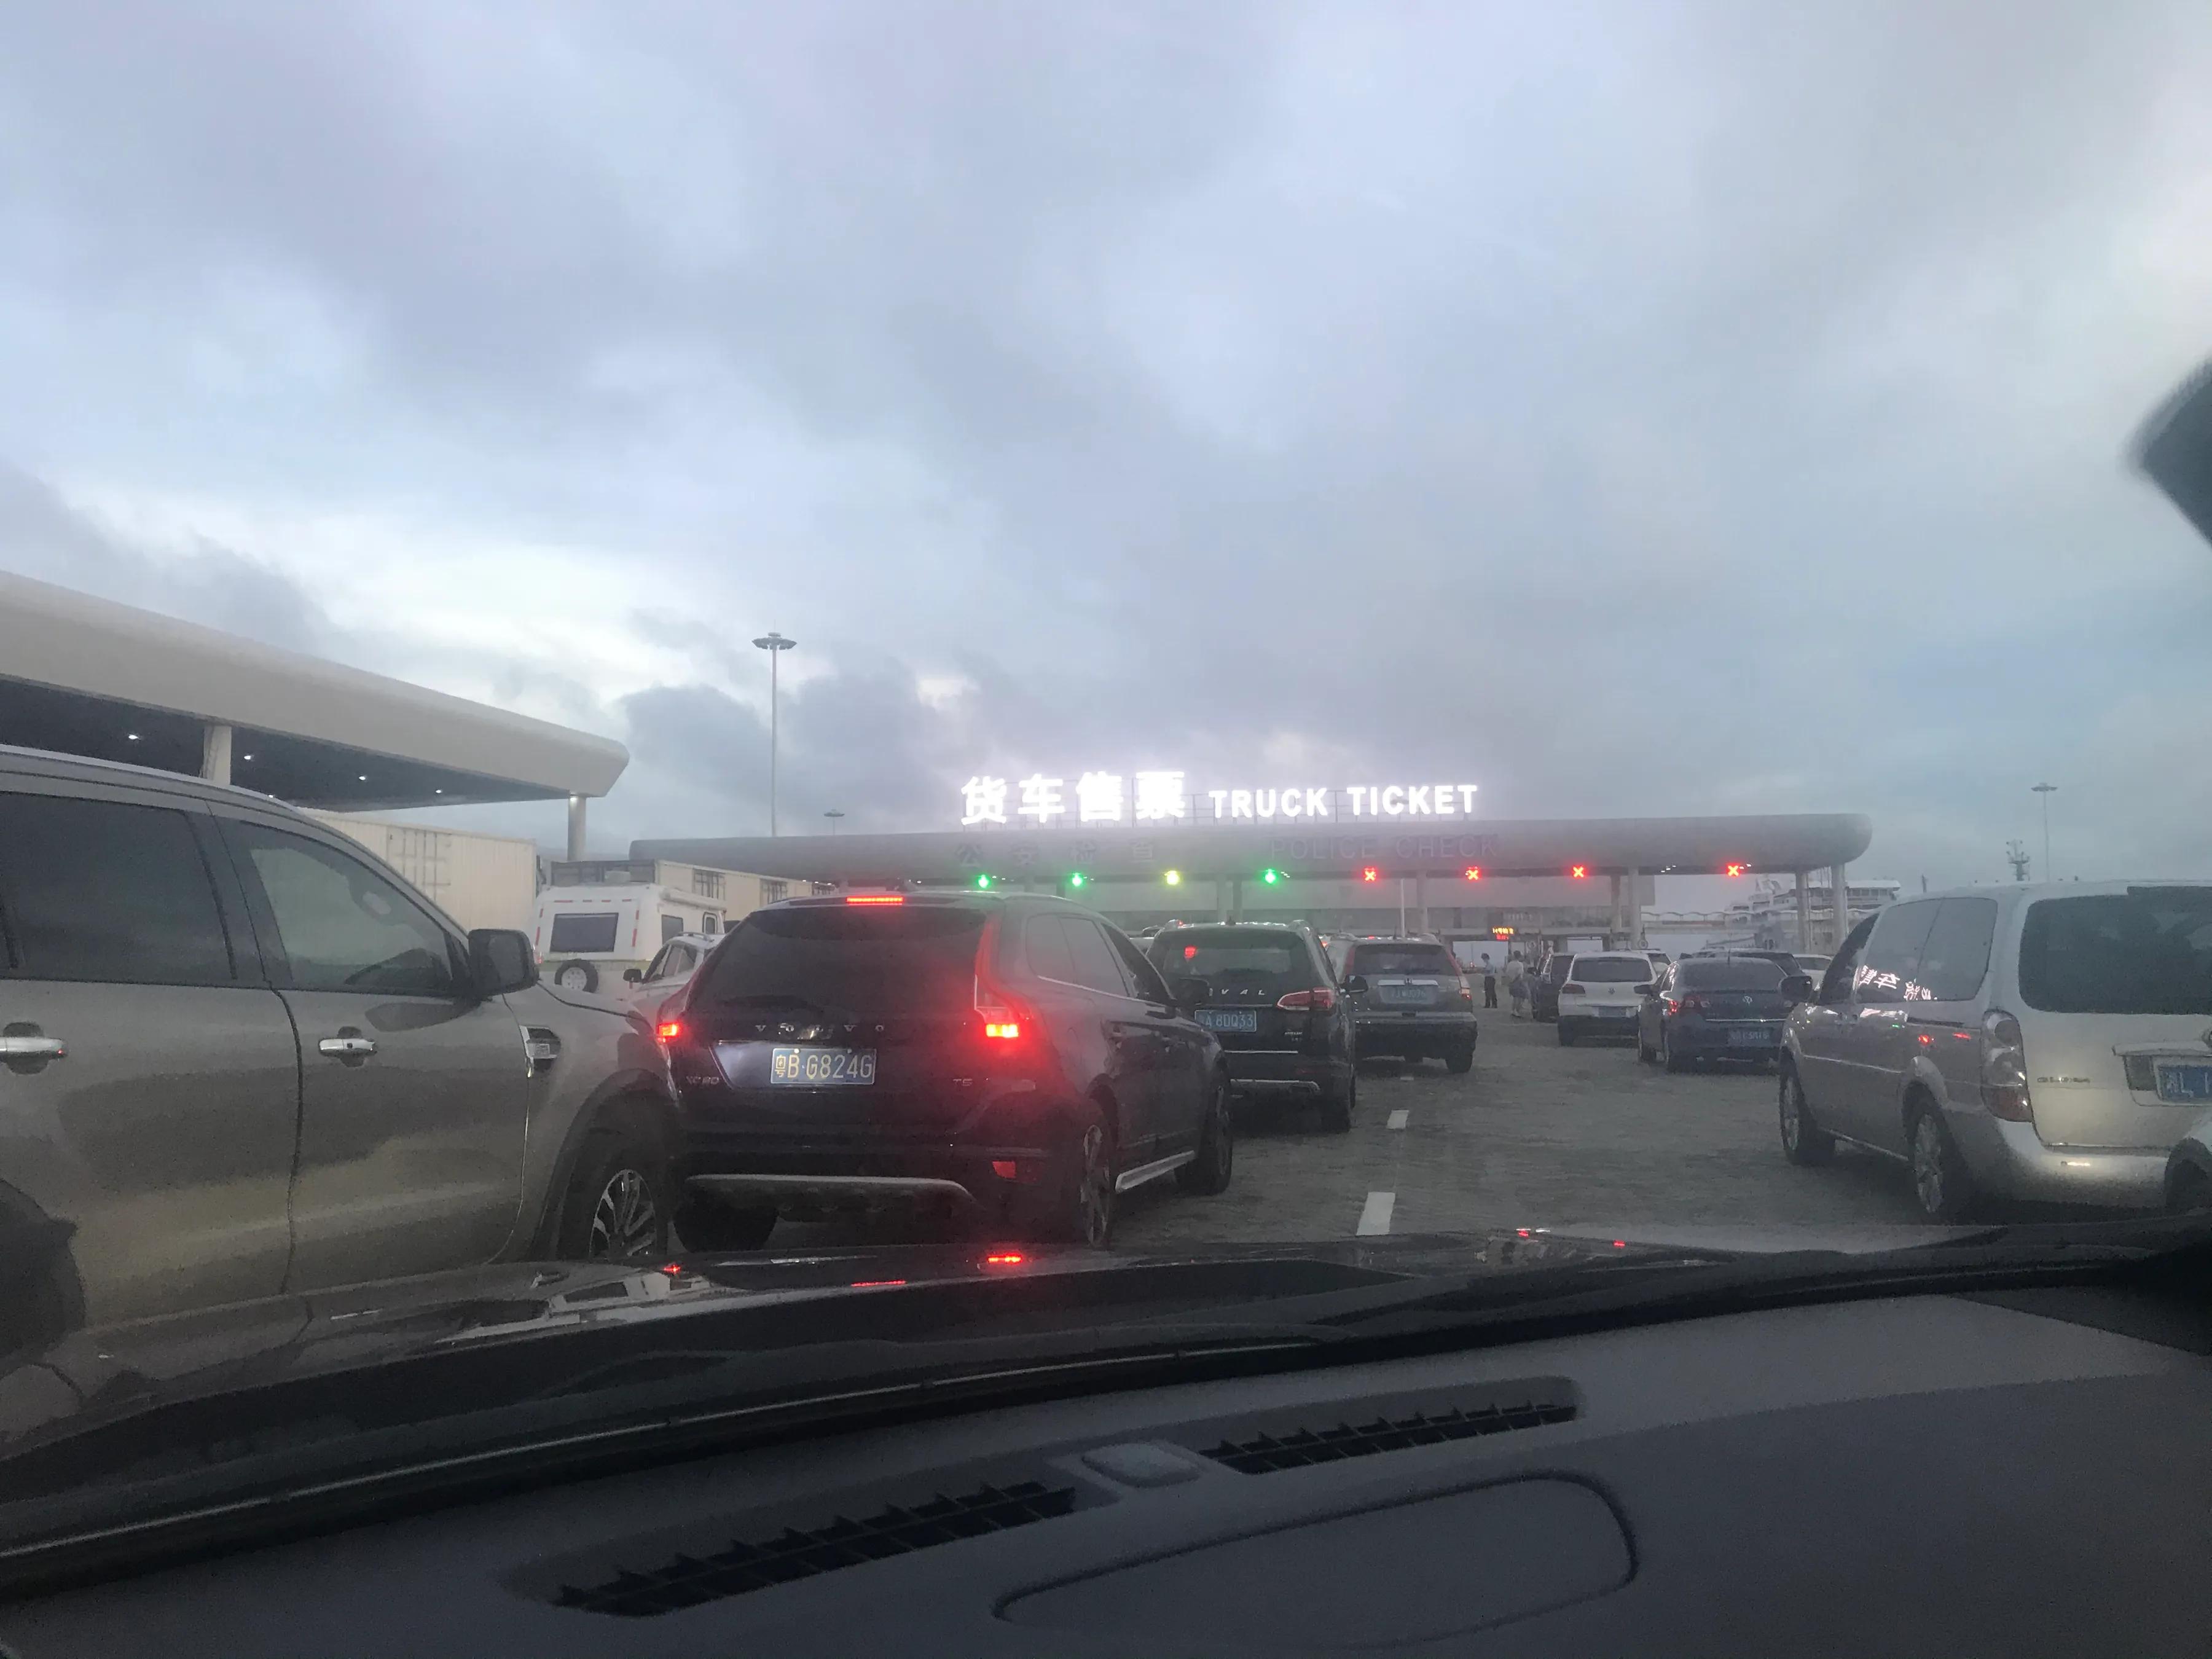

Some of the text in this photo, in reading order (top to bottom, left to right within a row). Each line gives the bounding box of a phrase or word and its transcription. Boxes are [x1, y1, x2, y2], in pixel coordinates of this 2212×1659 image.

[961, 771, 1185, 826] 货车售票
[1209, 785, 1477, 818] TRUCK TICKET
[1271, 833, 1497, 860] POLICE CHECK
